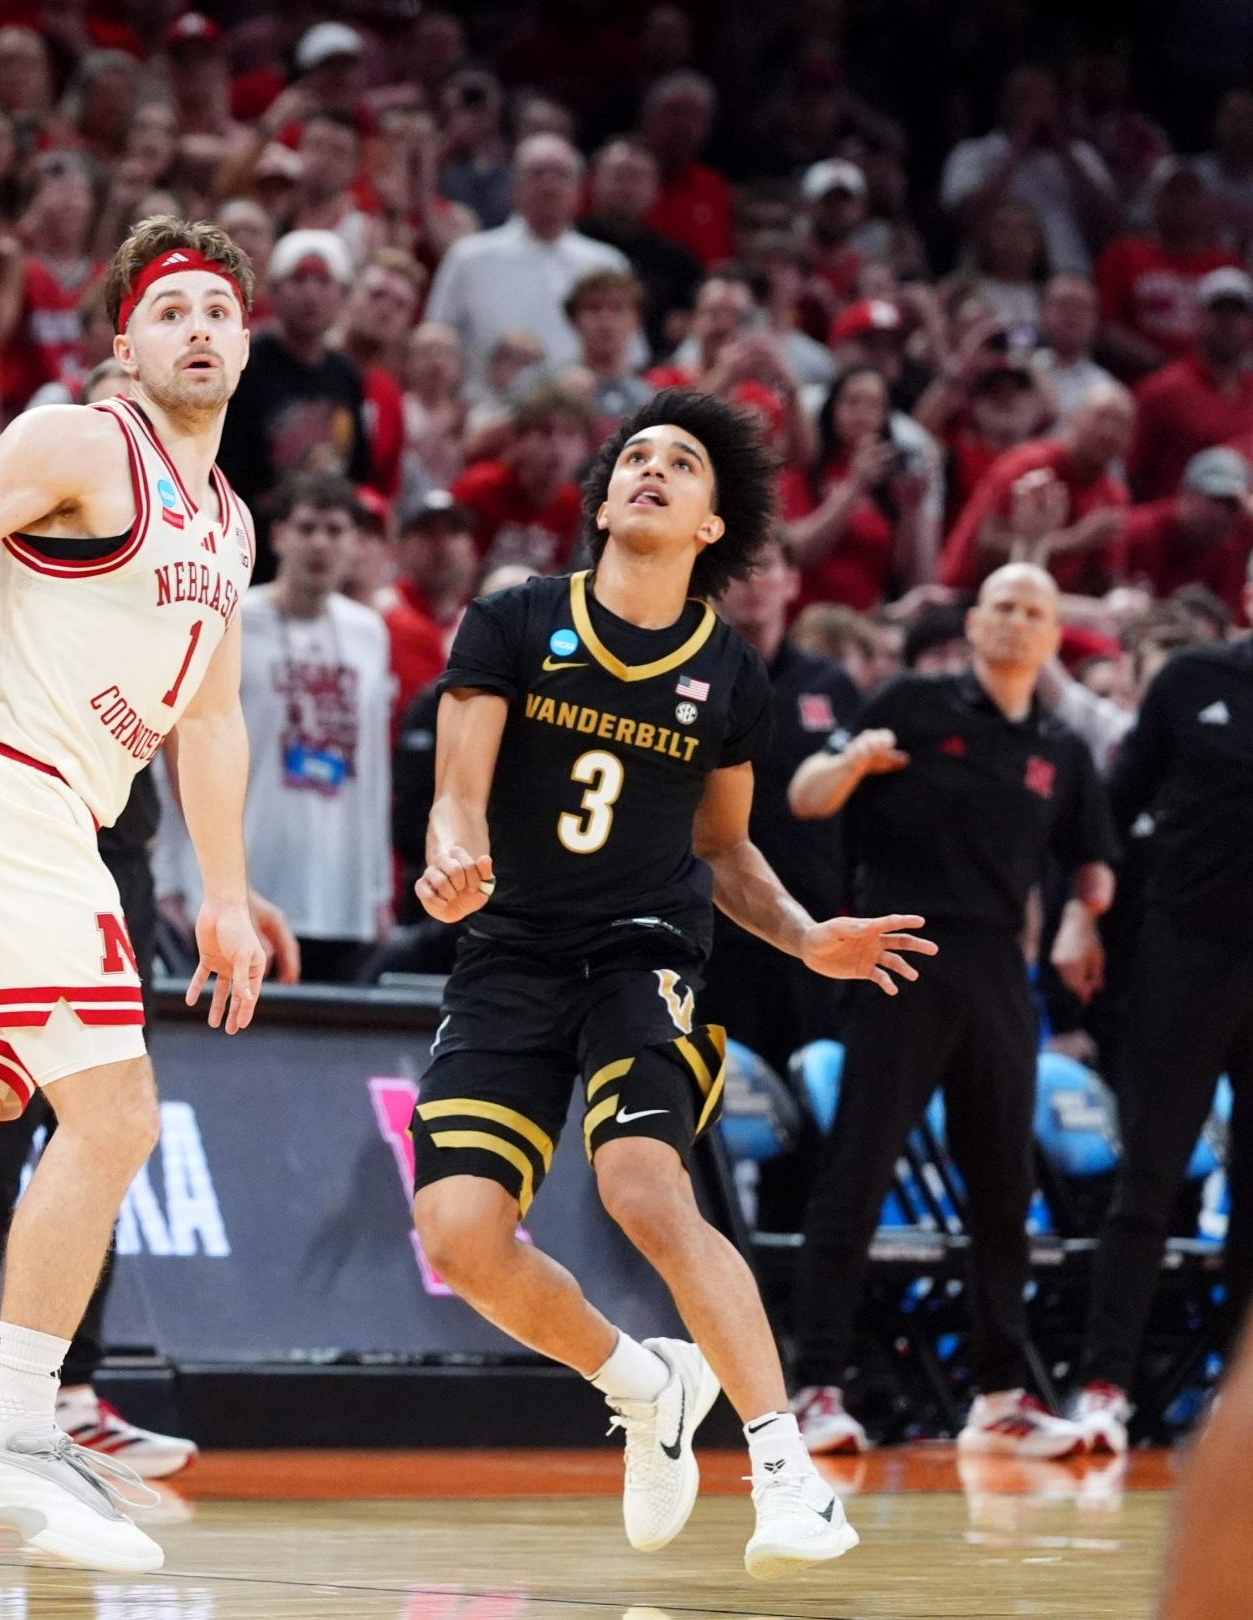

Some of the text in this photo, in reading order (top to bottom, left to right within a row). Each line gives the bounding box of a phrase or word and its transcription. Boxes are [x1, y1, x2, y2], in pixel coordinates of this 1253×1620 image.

[161, 620, 203, 708] 1
[525, 693, 699, 762] VANDERBILT
[557, 749, 625, 855] 3
